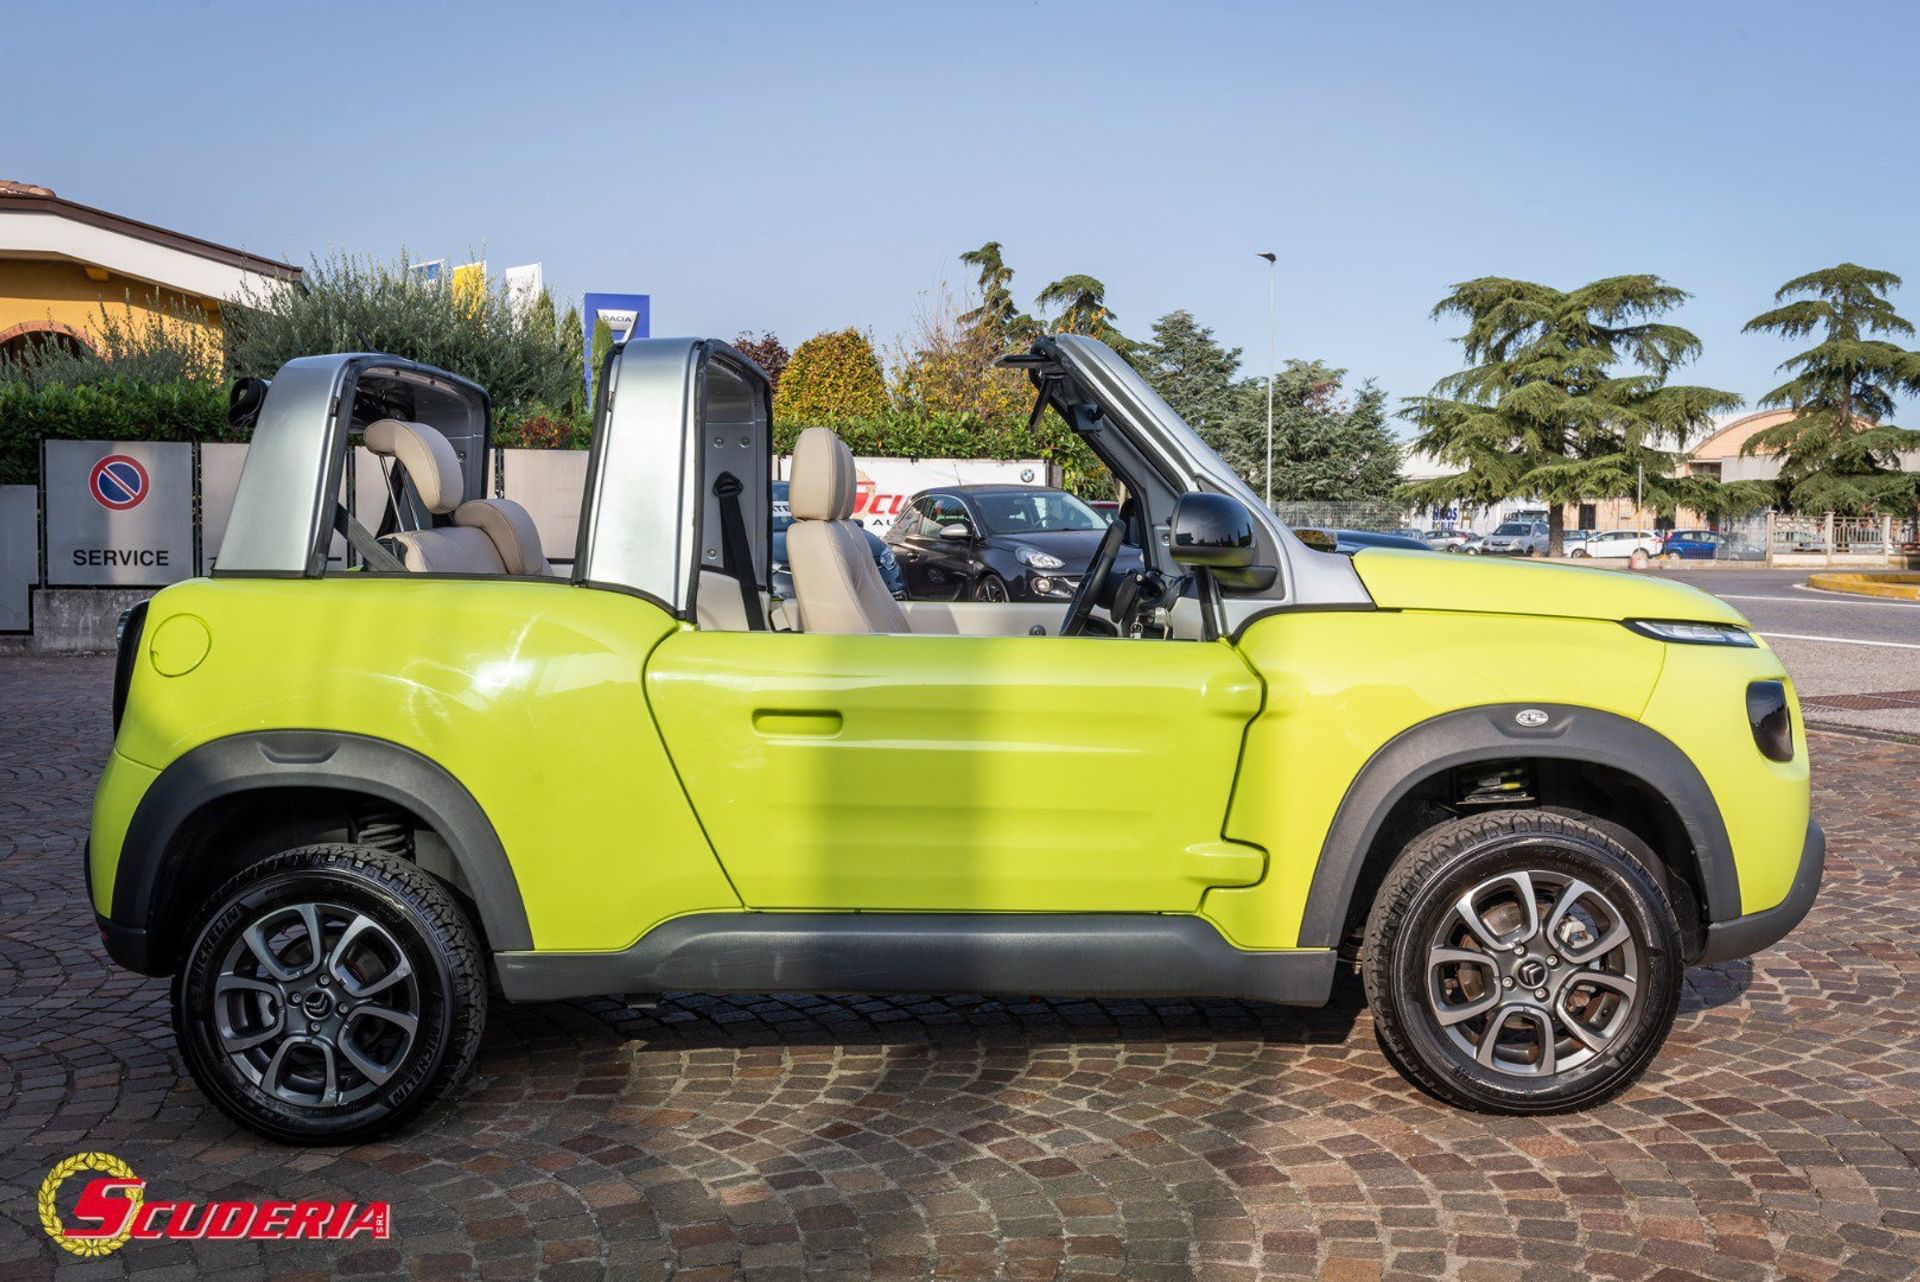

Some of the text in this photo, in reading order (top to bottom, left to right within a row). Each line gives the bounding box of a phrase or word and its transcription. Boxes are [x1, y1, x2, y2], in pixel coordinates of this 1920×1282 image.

[73, 550, 169, 566] SERVICE
[190, 902, 240, 982] MICHELIN
[389, 1026, 442, 1106] MICHELIN
